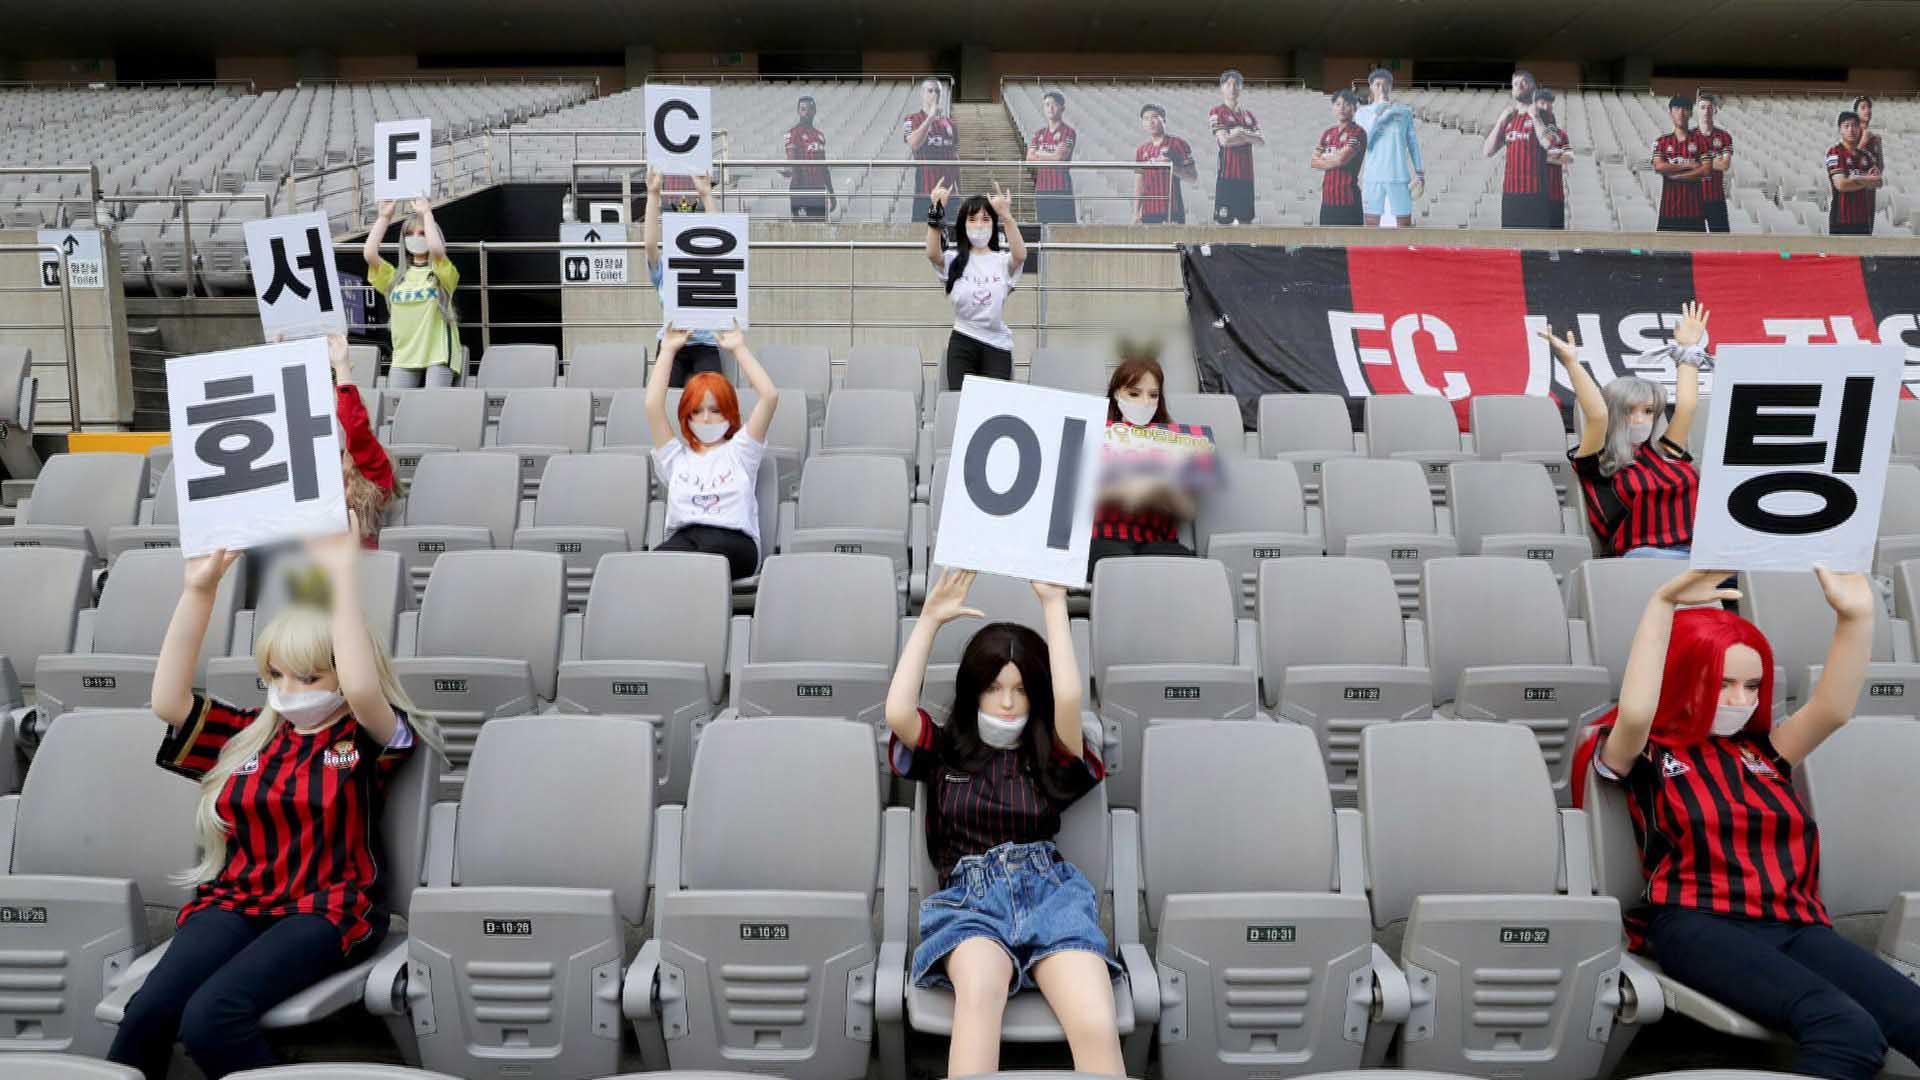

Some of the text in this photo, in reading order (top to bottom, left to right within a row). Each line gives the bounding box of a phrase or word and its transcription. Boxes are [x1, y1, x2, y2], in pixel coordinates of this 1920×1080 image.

[388, 132, 420, 180] F
[654, 101, 700, 154] C
[262, 228, 334, 313] 서
[593, 258, 623, 269] 화장실
[594, 270, 623, 280] Toilet
[668, 228, 745, 310] 울
[1328, 310, 1471, 400] FC
[187, 364, 333, 503] 화
[1722, 376, 1876, 535] 팅
[964, 414, 1087, 551] 이
